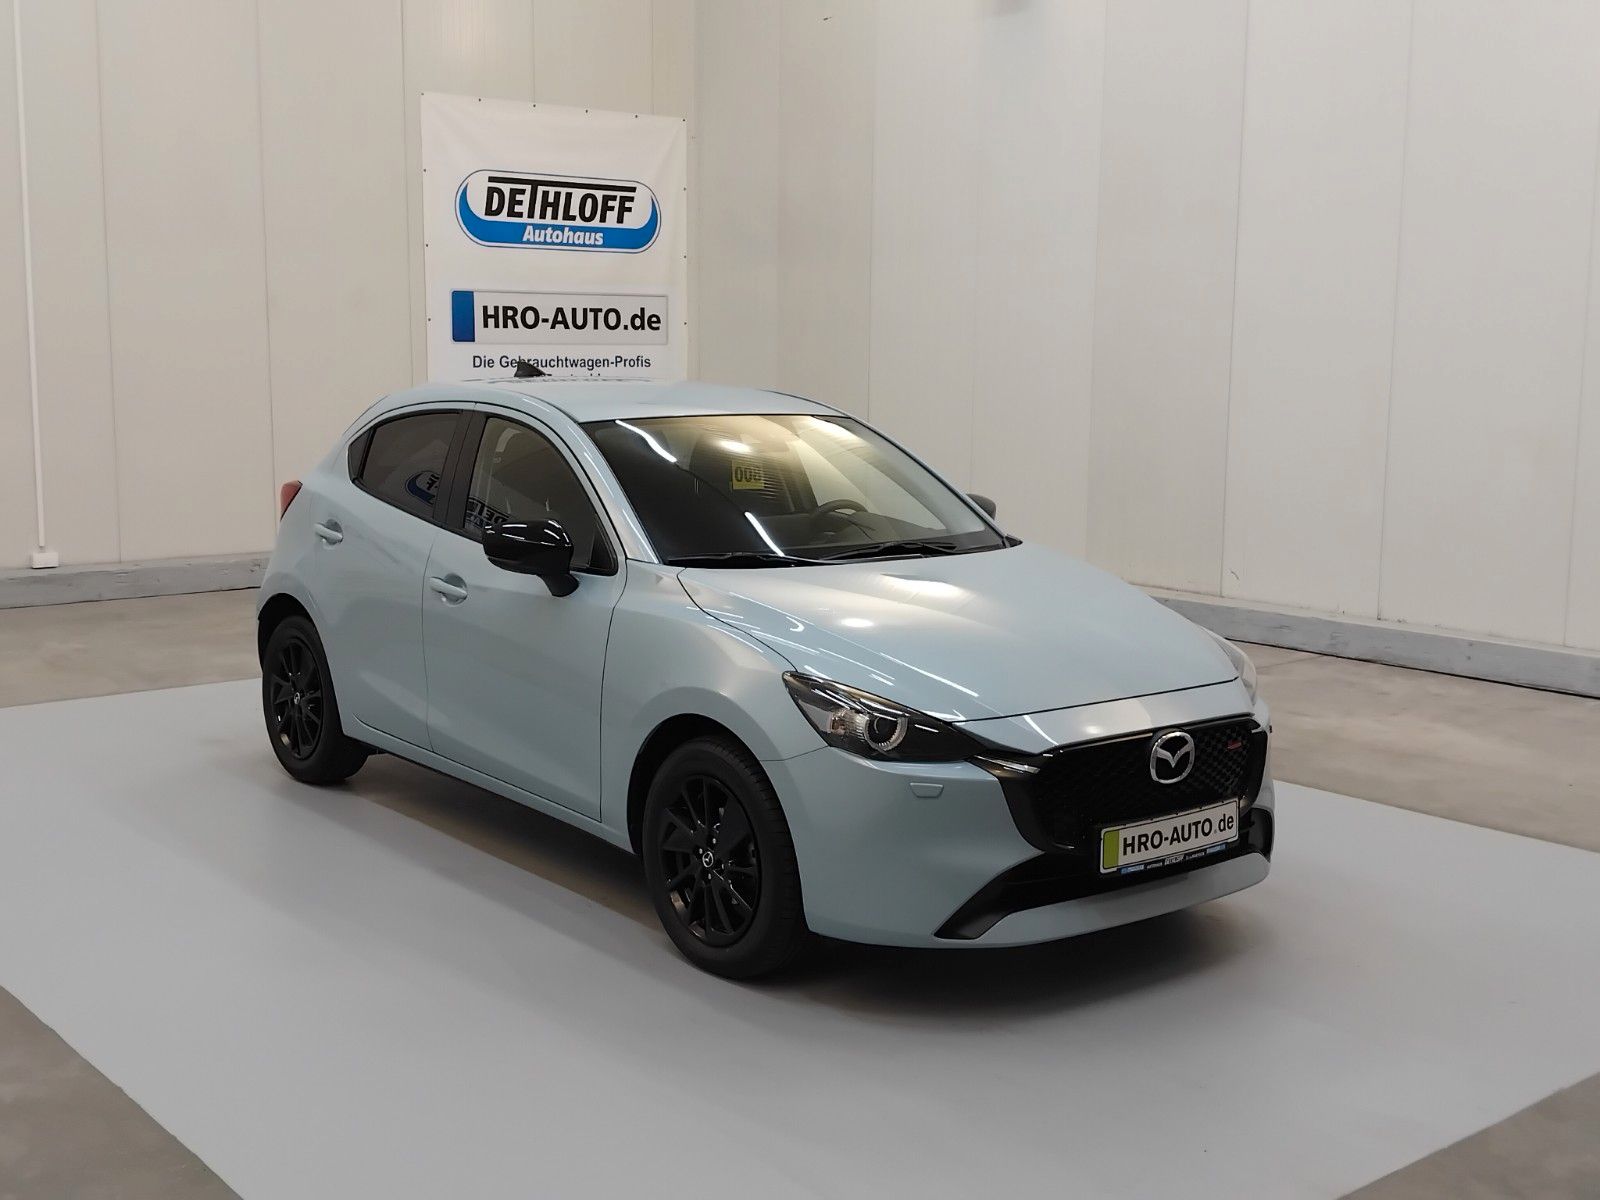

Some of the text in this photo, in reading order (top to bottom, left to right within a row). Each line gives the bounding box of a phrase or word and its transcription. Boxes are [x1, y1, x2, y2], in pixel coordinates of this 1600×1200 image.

[484, 176, 637, 224] DETHLOFF
[522, 225, 604, 245] Autohaus
[482, 305, 662, 331] HRO-AUTO.de
[472, 355, 495, 369] Die
